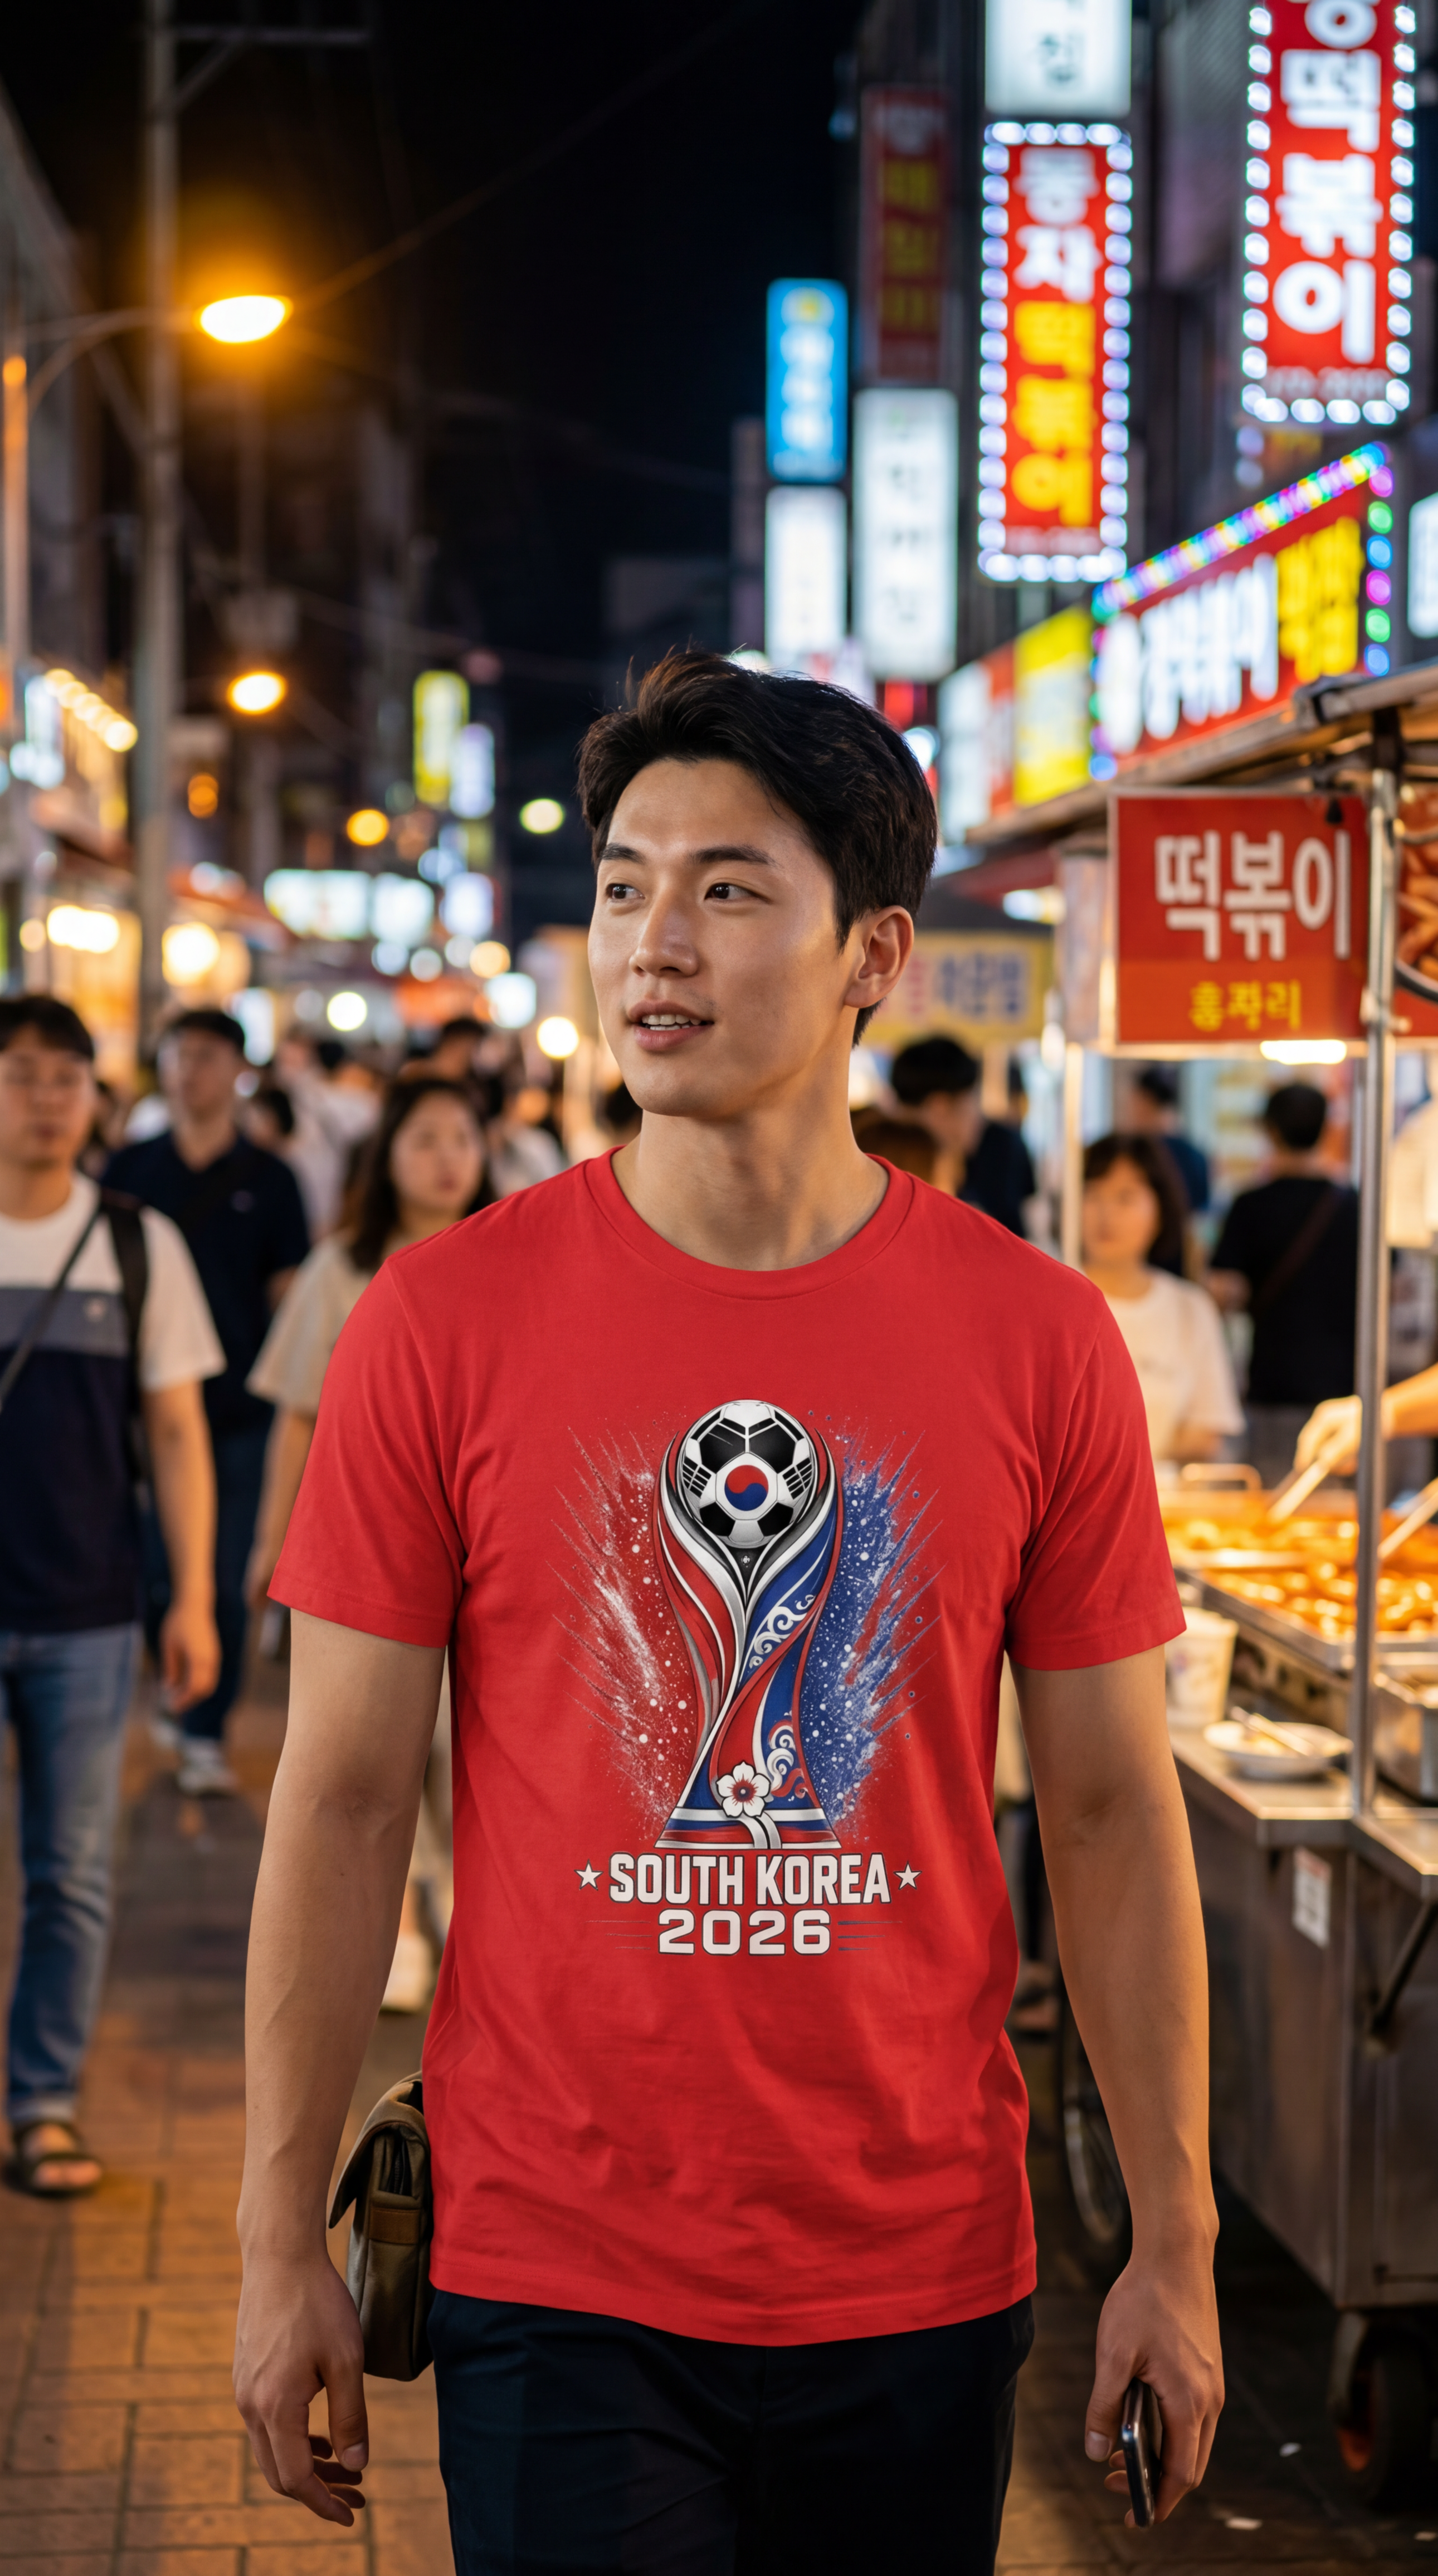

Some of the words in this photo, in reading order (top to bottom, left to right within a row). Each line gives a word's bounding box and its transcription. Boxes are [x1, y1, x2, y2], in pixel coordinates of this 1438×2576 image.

[1154, 830, 1351, 962] 떡볶이
[609, 1852, 744, 1905] SOUTH
[756, 1852, 892, 1905] KOREA
[657, 1908, 831, 1956] 2026
